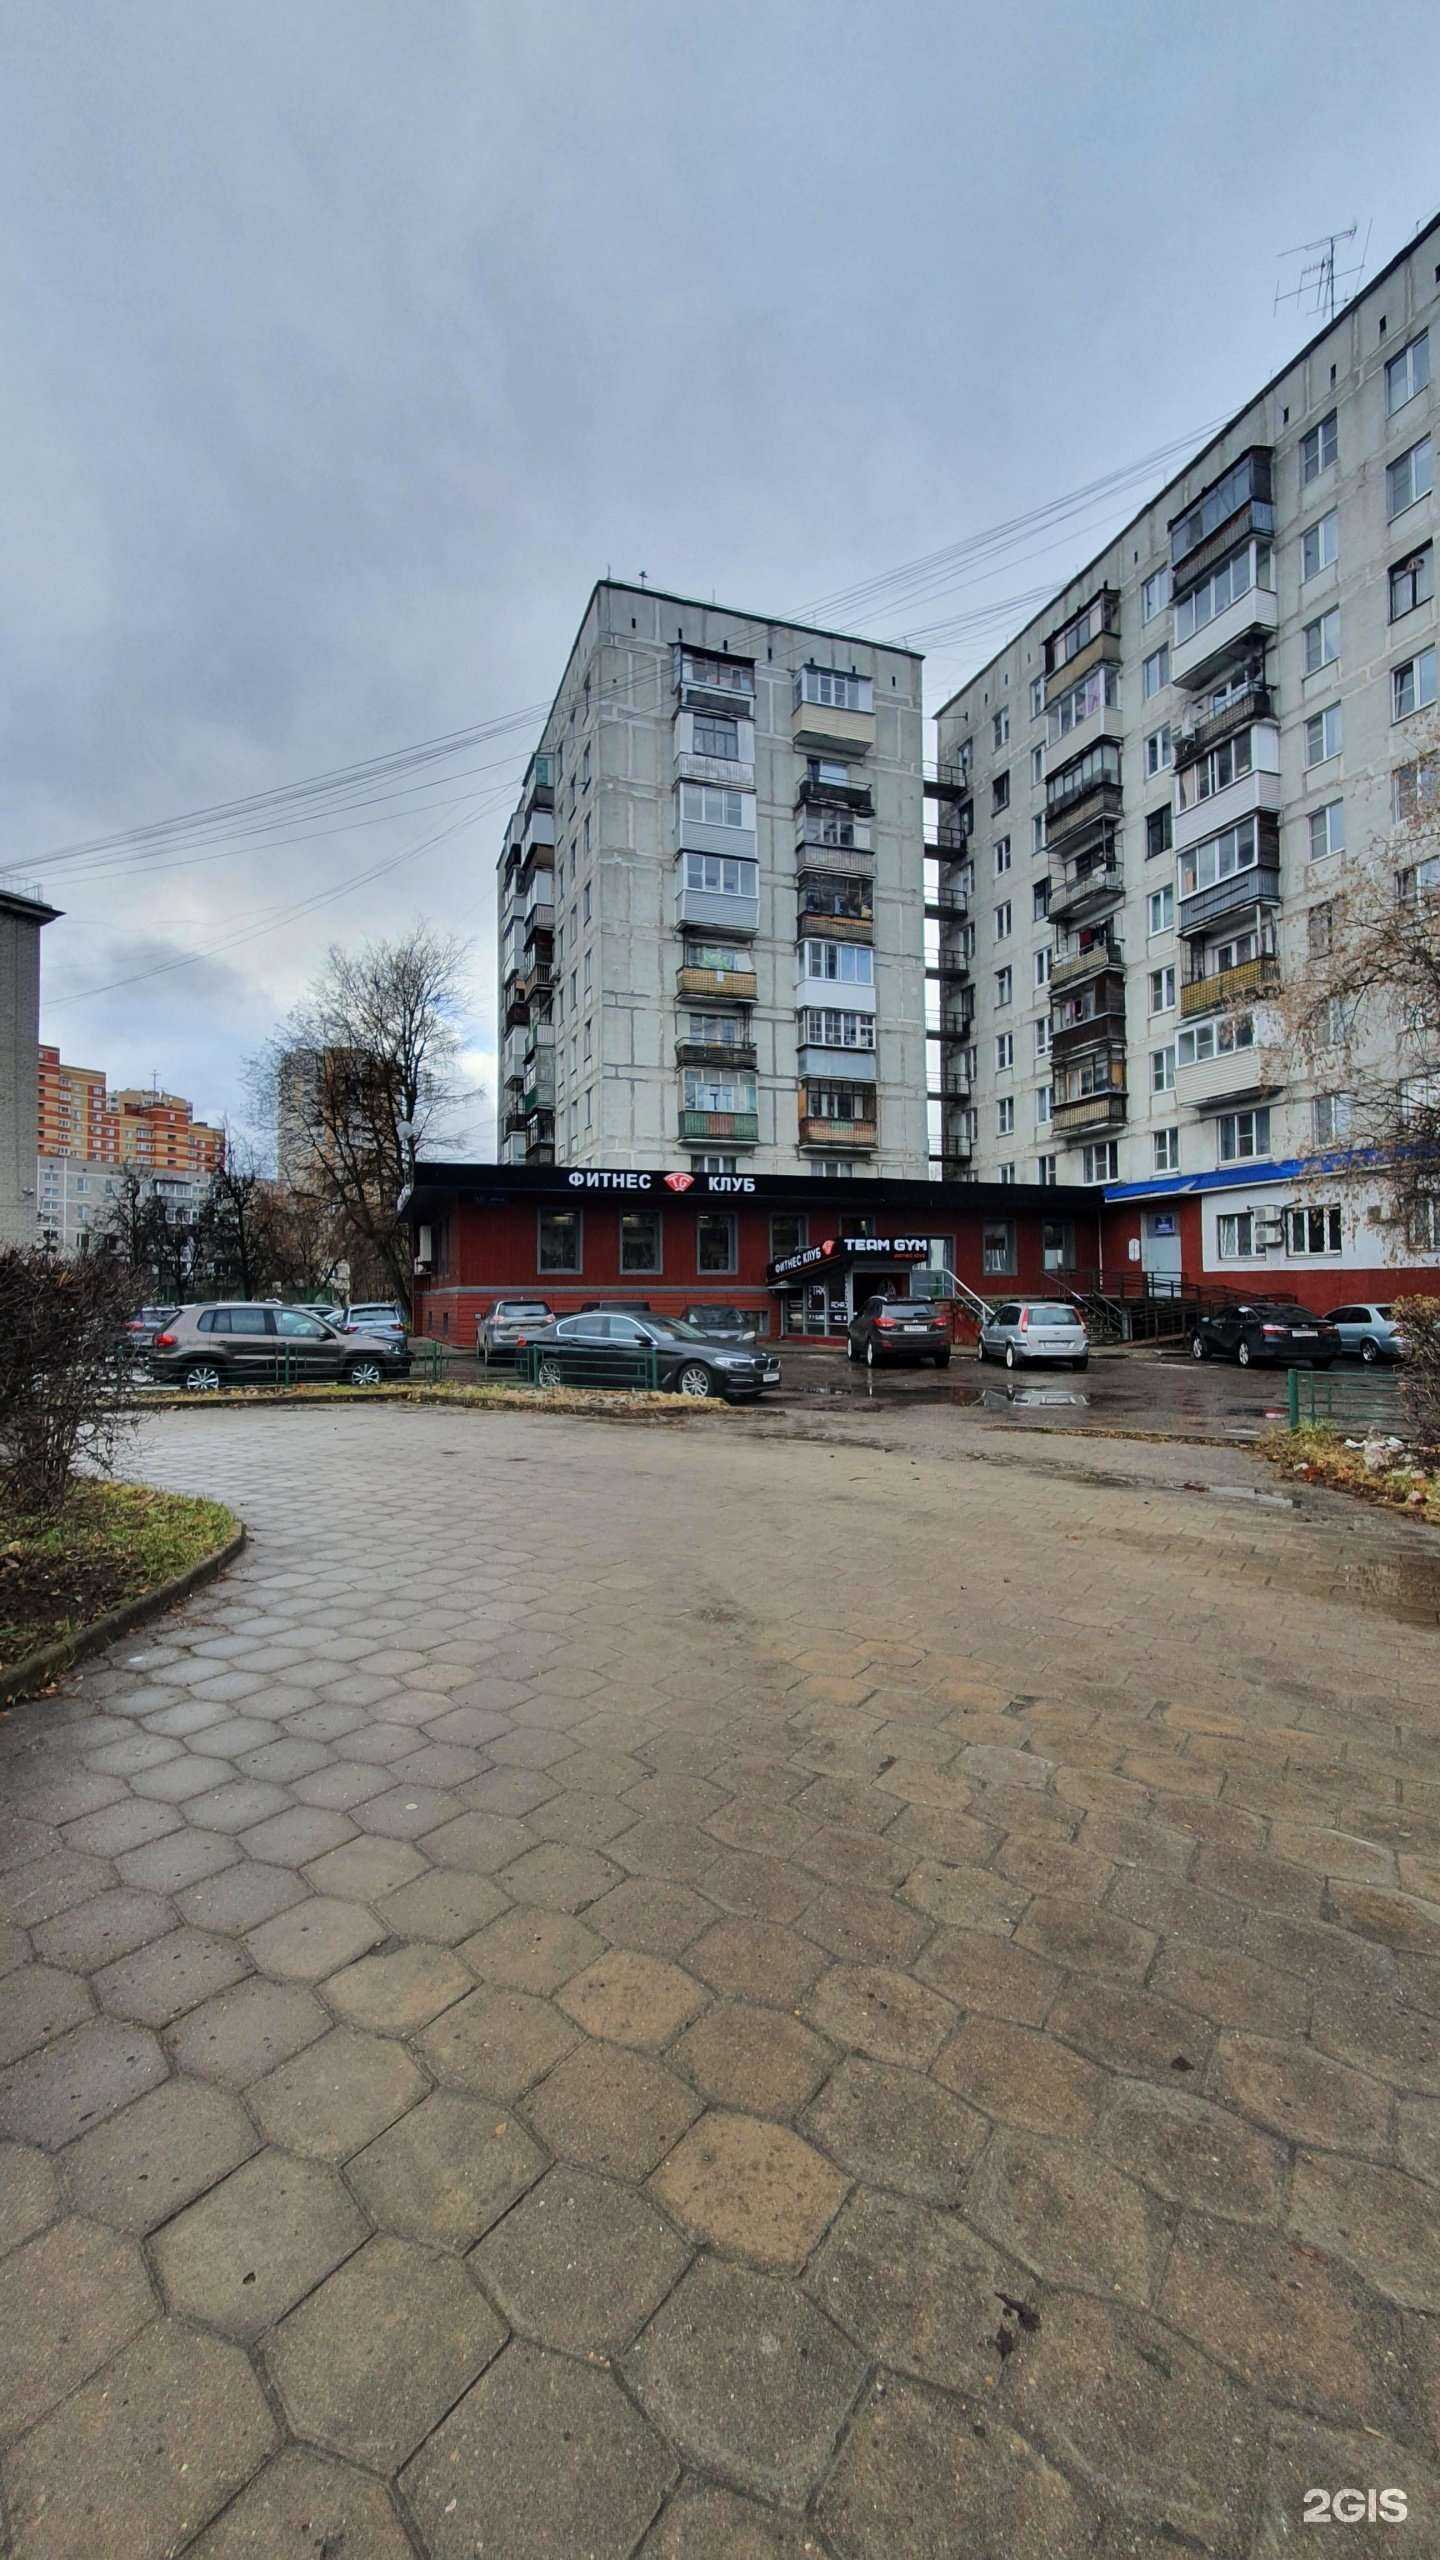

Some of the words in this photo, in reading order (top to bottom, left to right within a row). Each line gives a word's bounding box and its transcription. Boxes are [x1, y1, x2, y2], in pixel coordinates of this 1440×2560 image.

[568, 1171, 652, 1189] ФИТНЕС
[708, 1176, 756, 1192] КЛУБ
[843, 1238, 890, 1251] TEAM
[894, 1238, 928, 1251] GYM
[774, 1254, 802, 1273] ФИТНЕС
[802, 1247, 822, 1264] КЛУБ
